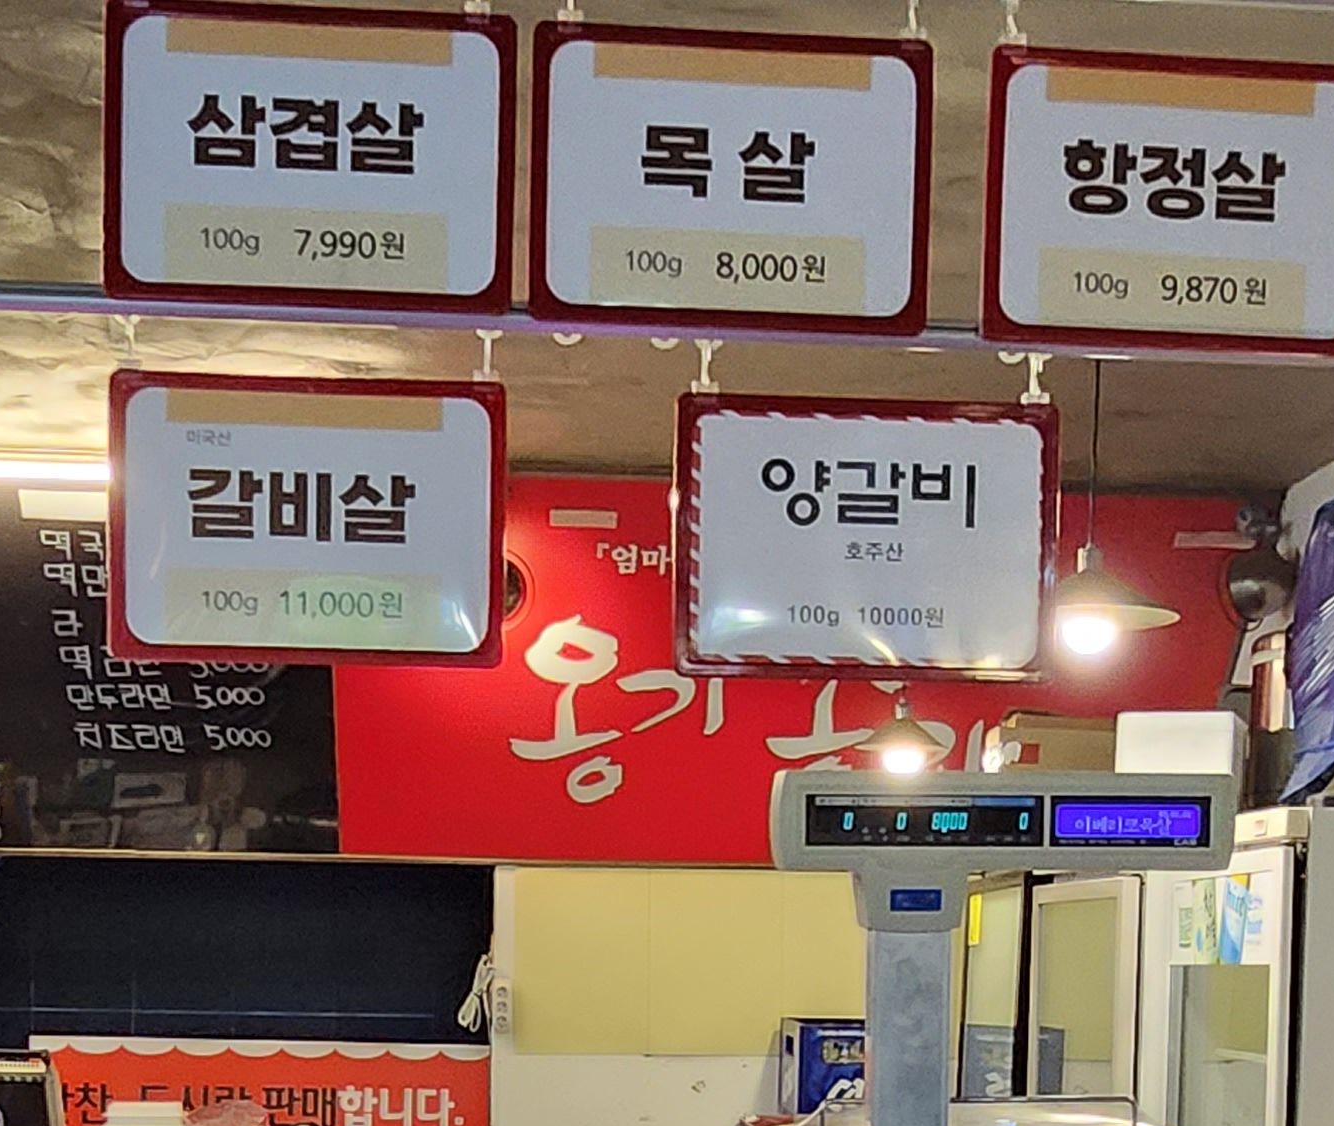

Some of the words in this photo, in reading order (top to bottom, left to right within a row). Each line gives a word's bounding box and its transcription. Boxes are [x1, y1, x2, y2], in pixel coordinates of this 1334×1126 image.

[187, 93, 424, 175] 삼겹살
[1063, 139, 1287, 222] 항정살
[199, 227, 261, 256] 100g
[293, 228, 406, 261] 7,990원
[625, 250, 683, 278] 100g
[715, 252, 827, 284] 8,000원
[1073, 271, 1130, 299] 100g
[186, 429, 232, 447] 미국산
[187, 468, 416, 543] 갈비살
[761, 458, 977, 529] 양갈비
[845, 542, 904, 562] 호주산
[201, 590, 258, 617] 100g
[279, 591, 403, 619] 11,000원
[787, 605, 840, 627] 100g
[857, 606, 945, 629] 10000원
